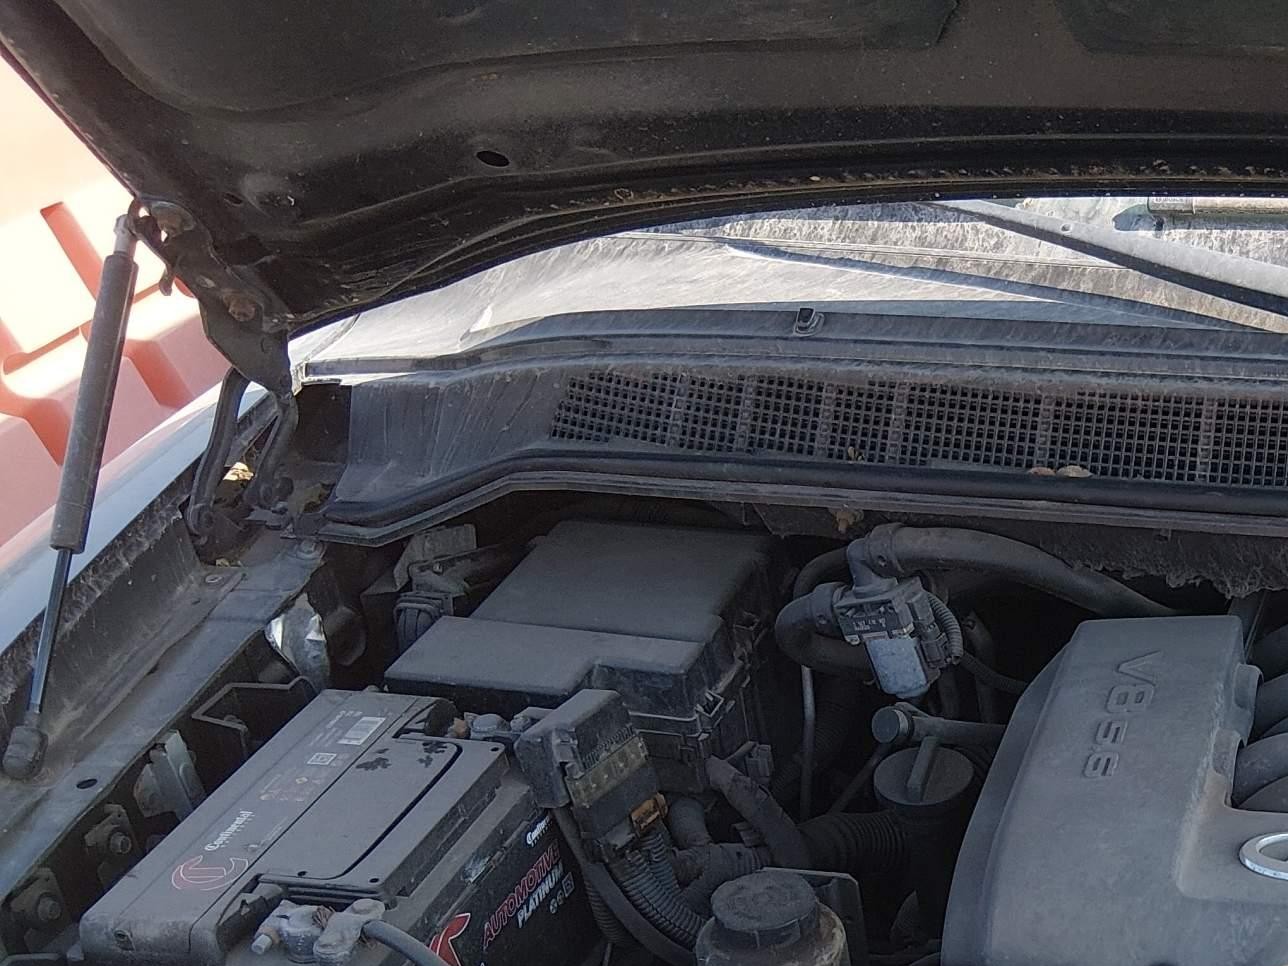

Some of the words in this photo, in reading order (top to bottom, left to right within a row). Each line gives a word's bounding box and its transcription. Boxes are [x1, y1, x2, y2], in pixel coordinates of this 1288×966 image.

[204, 809, 254, 851] Continental
[482, 840, 561, 951] AUTOMOTIVE
[517, 861, 564, 929] PLATINUM
